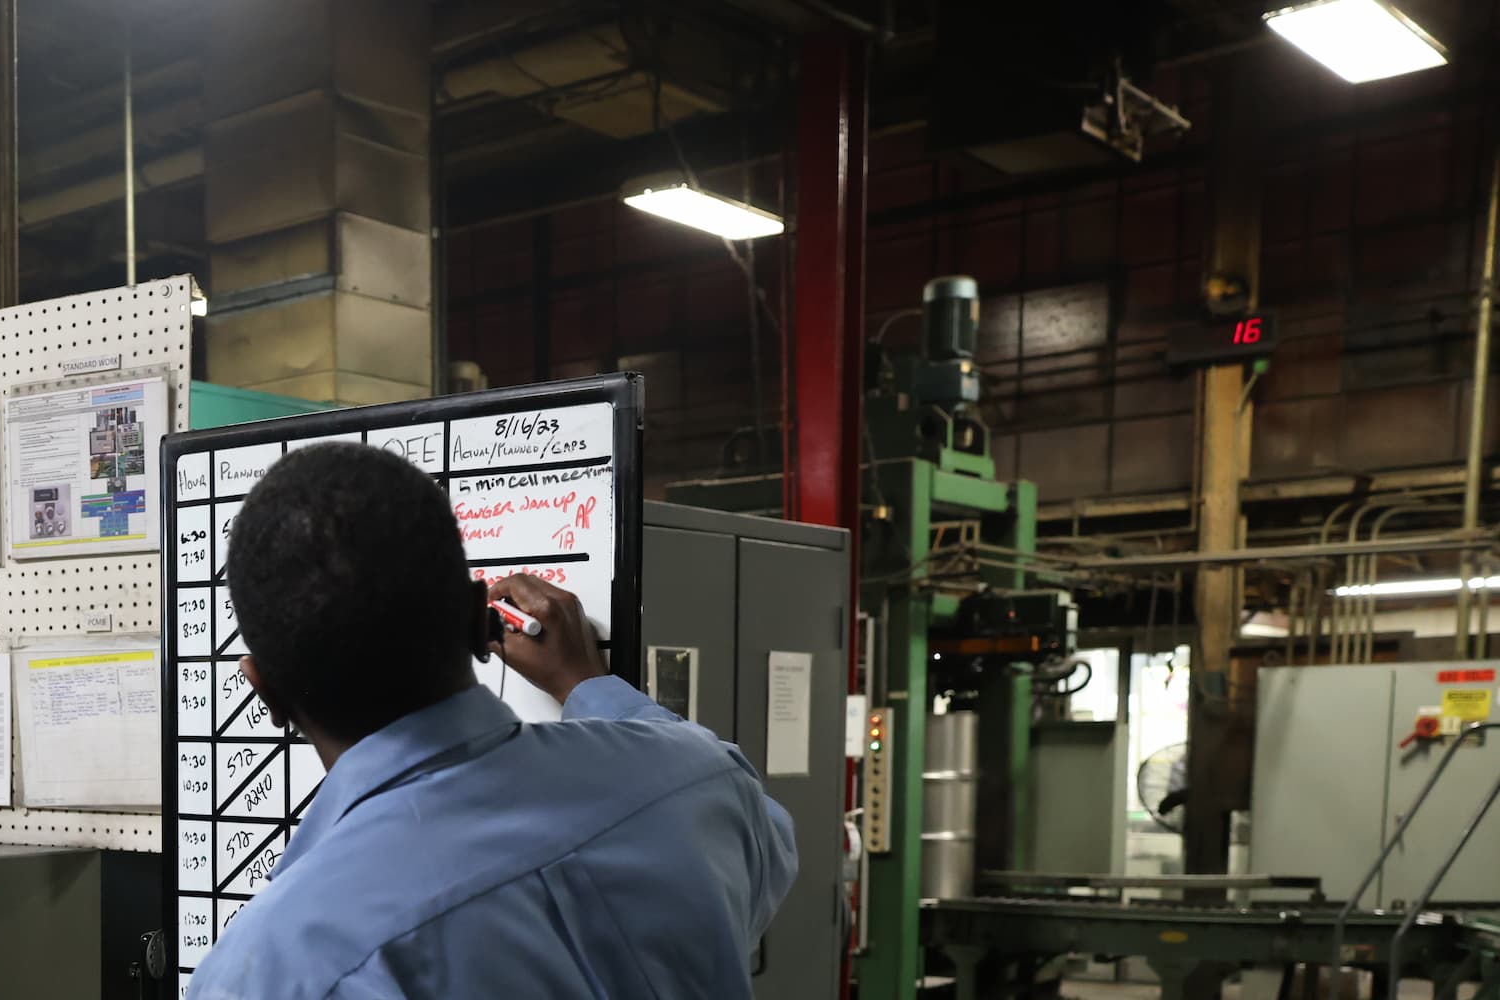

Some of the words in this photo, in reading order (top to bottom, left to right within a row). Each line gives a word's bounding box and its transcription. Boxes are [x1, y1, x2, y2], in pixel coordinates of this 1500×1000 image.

[1233, 317, 1263, 345] 16
[63, 360, 97, 372] STANDARD
[98, 357, 118, 367] WORK
[494, 412, 560, 440] 8/16/23
[181, 549, 205, 567] 7:30
[179, 598, 205, 613] 7:30
[183, 622, 207, 638] 8:30
[182, 668, 207, 682] 8:30
[181, 695, 207, 710] 9:30
[227, 748, 259, 778] 572
[226, 831, 255, 859] 572
